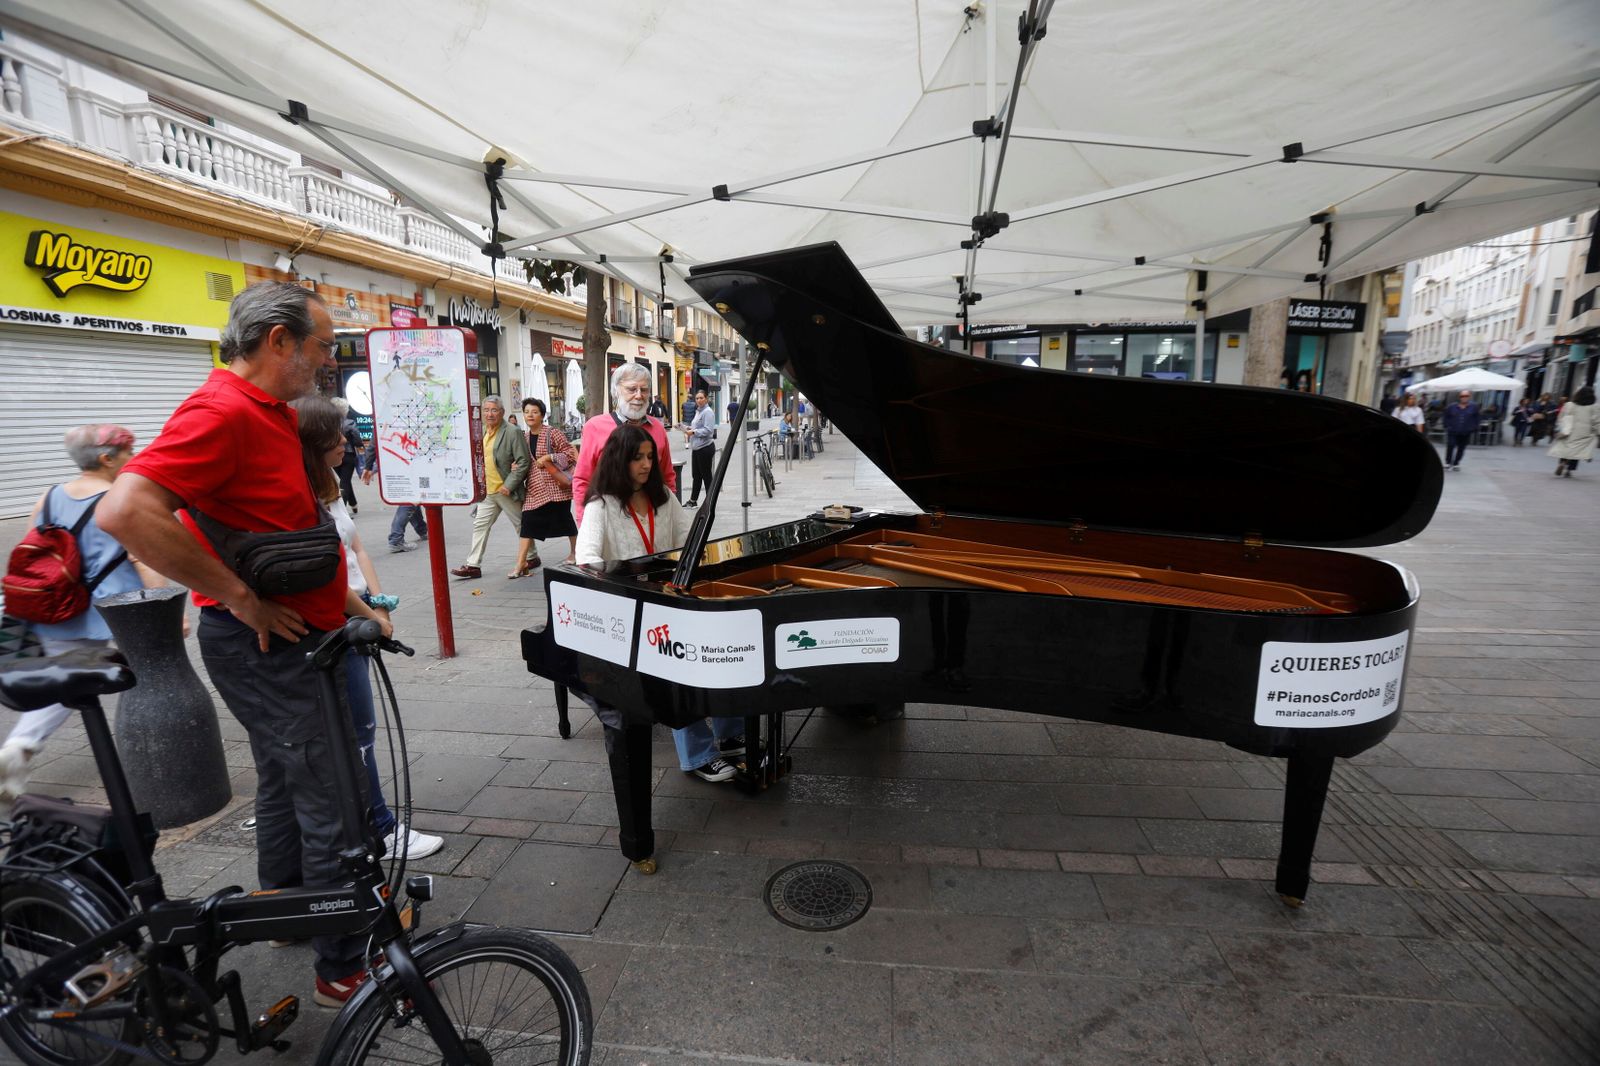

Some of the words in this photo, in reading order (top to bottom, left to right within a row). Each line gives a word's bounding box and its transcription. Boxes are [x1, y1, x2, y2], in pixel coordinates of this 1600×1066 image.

[31, 231, 151, 281] Moyano
[1288, 303, 1320, 318] LÁSER
[1322, 306, 1356, 320] SESIÓN
[0, 307, 62, 324] LOSINAS
[73, 316, 143, 332] APERITIVOS
[152, 324, 187, 336] FIESTA
[572, 609, 604, 625] Fundación
[610, 616, 626, 634] 25
[589, 623, 606, 634] Serra
[647, 624, 670, 646] OFF
[834, 629, 874, 637] FUNDACIÓN
[611, 633, 626, 643] años
[658, 638, 698, 662] MCB
[727, 643, 756, 653] Canals
[861, 647, 888, 655] COVAP
[701, 655, 744, 664] Barcelona
[1270, 655, 1361, 673] ¿QUIERES
[1267, 687, 1381, 703] #PianosCordoba
[1275, 708, 1355, 717] mariacanals.org
[310, 899, 354, 912] quipplan
